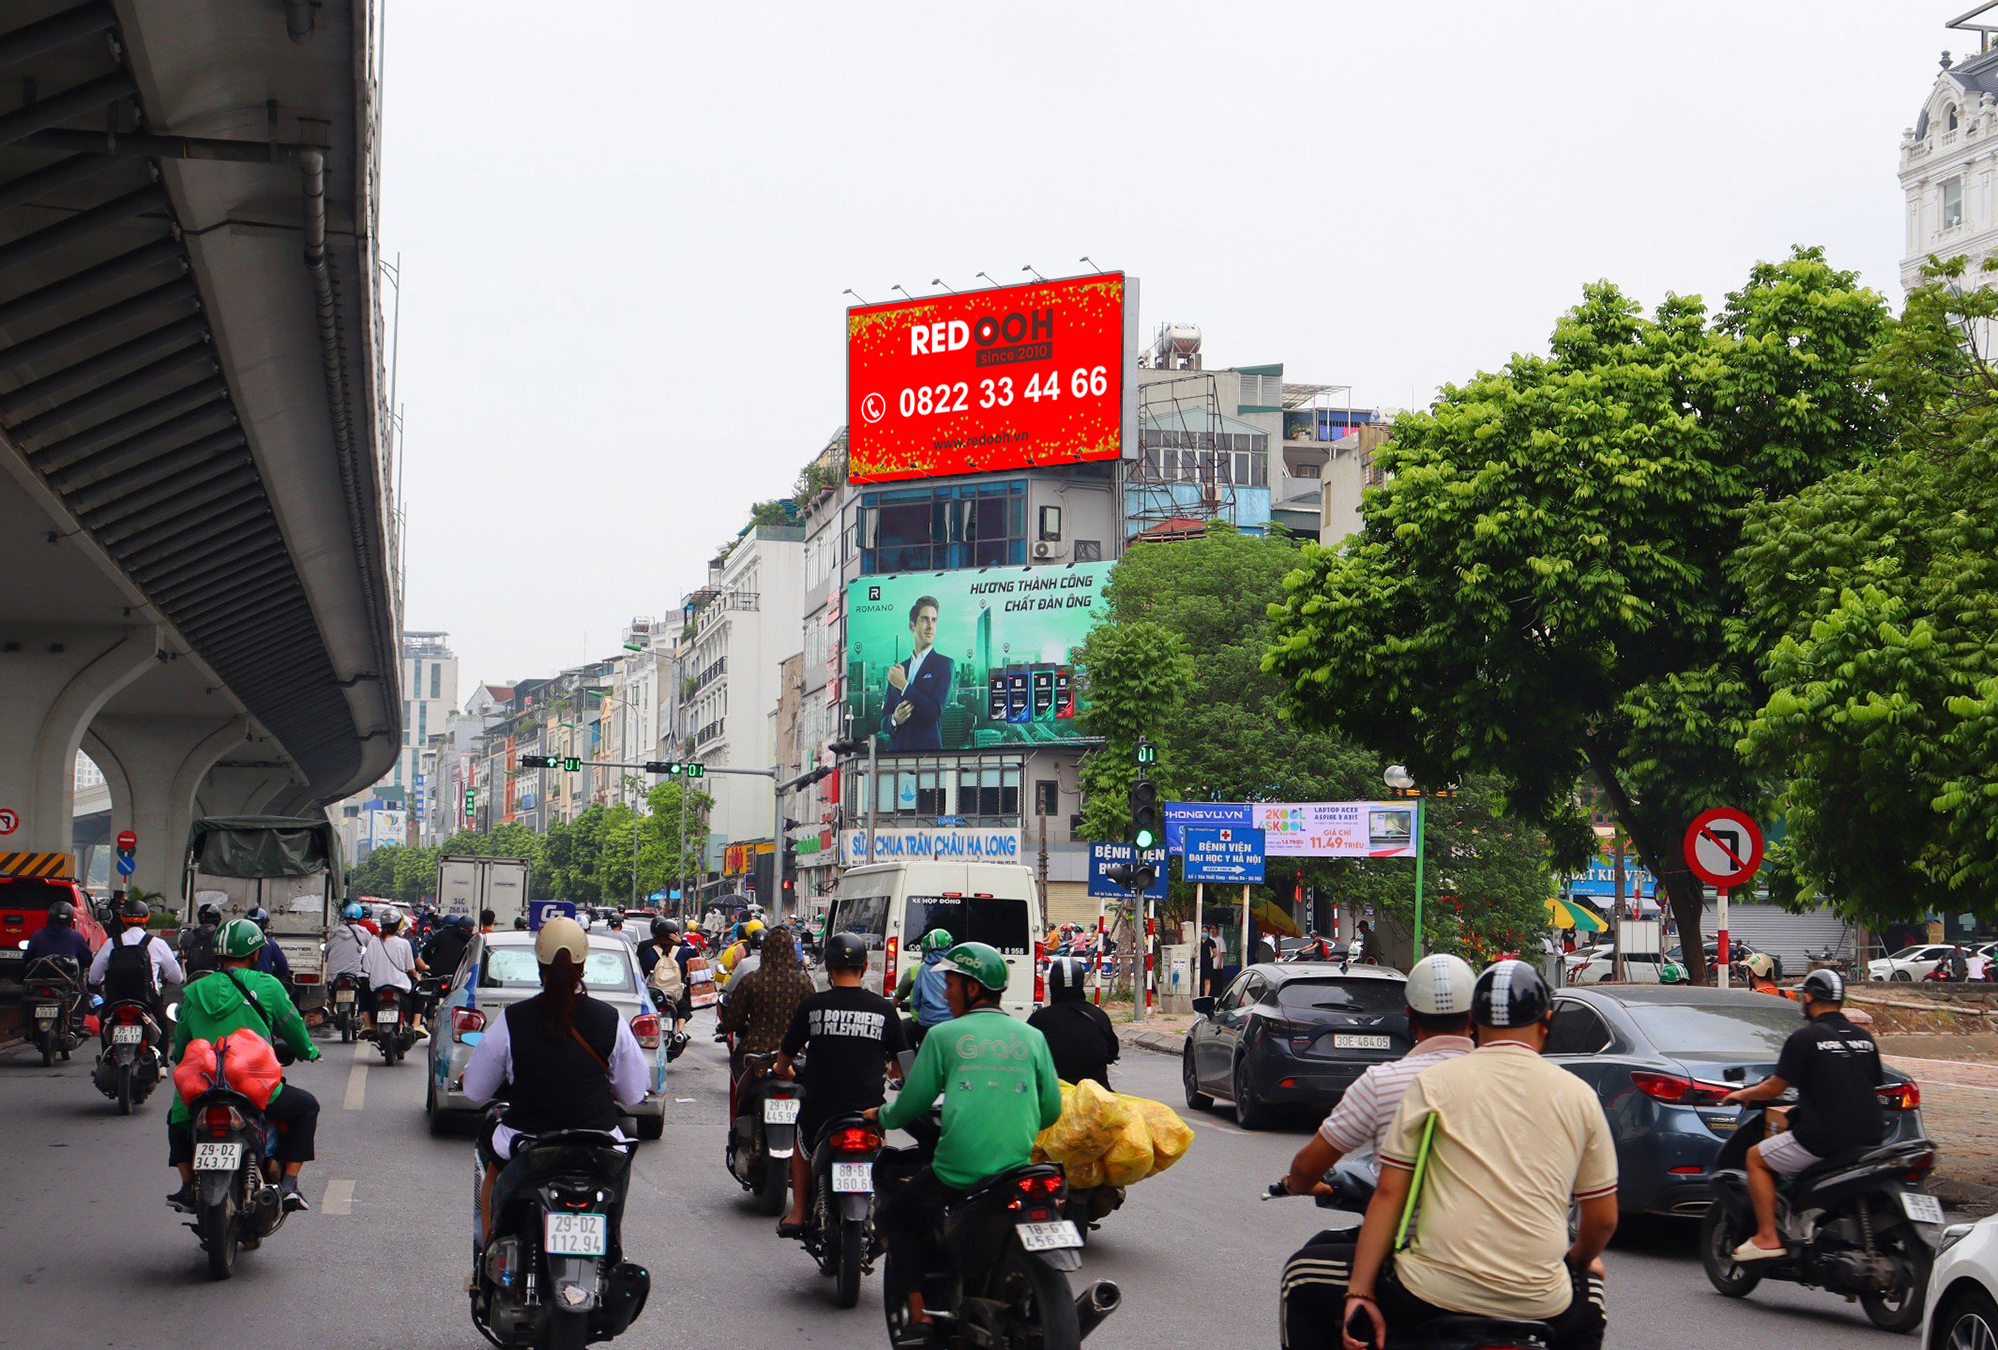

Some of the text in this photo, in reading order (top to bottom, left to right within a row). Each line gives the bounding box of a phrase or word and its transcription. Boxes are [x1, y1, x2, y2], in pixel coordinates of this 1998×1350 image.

[911, 308, 1053, 356] RED OOH
[980, 345, 1048, 365] since 2010
[899, 365, 1108, 418] 0822 33 44 66
[933, 431, 1029, 450] www.redooh.vn
[970, 573, 1093, 595] HƯƠNG THÀNH CÔNG
[856, 604, 894, 613] ROMANO
[1004, 593, 1092, 612] CHẤT ĐÀN ÔNG
[1138, 747, 1154, 762] 01
[688, 764, 703, 777] 01
[1323, 827, 1337, 836] GIÁ
[875, 835, 903, 857] CHUA
[905, 831, 932, 857] TRÂN
[935, 831, 964, 857] CHÂU
[967, 835, 983, 860] HẠ
[985, 835, 1016, 857] LONG
[1198, 840, 1252, 854] BỆNH VIỆN
[1309, 836, 1343, 849] 11.49
[1095, 844, 1131, 861] BỆNH
[1188, 852, 1261, 865] ĐẠI HỌC Y HÀ NỘI
[954, 953, 983, 970] Grab
[809, 1009, 886, 1028] NO BOYFRIEND
[810, 1022, 883, 1041] NO MLEMMLEM
[956, 1033, 1029, 1061] Grab
[1336, 1036, 1389, 1049] 30E-464.05
[769, 1100, 795, 1111] 29-V7
[201, 1144, 235, 1156] 29-D2
[196, 1157, 236, 1168] 343.71
[840, 1165, 871, 1177] 88-B1
[555, 1216, 597, 1234] 29-D2
[551, 1234, 601, 1253] 112.94
